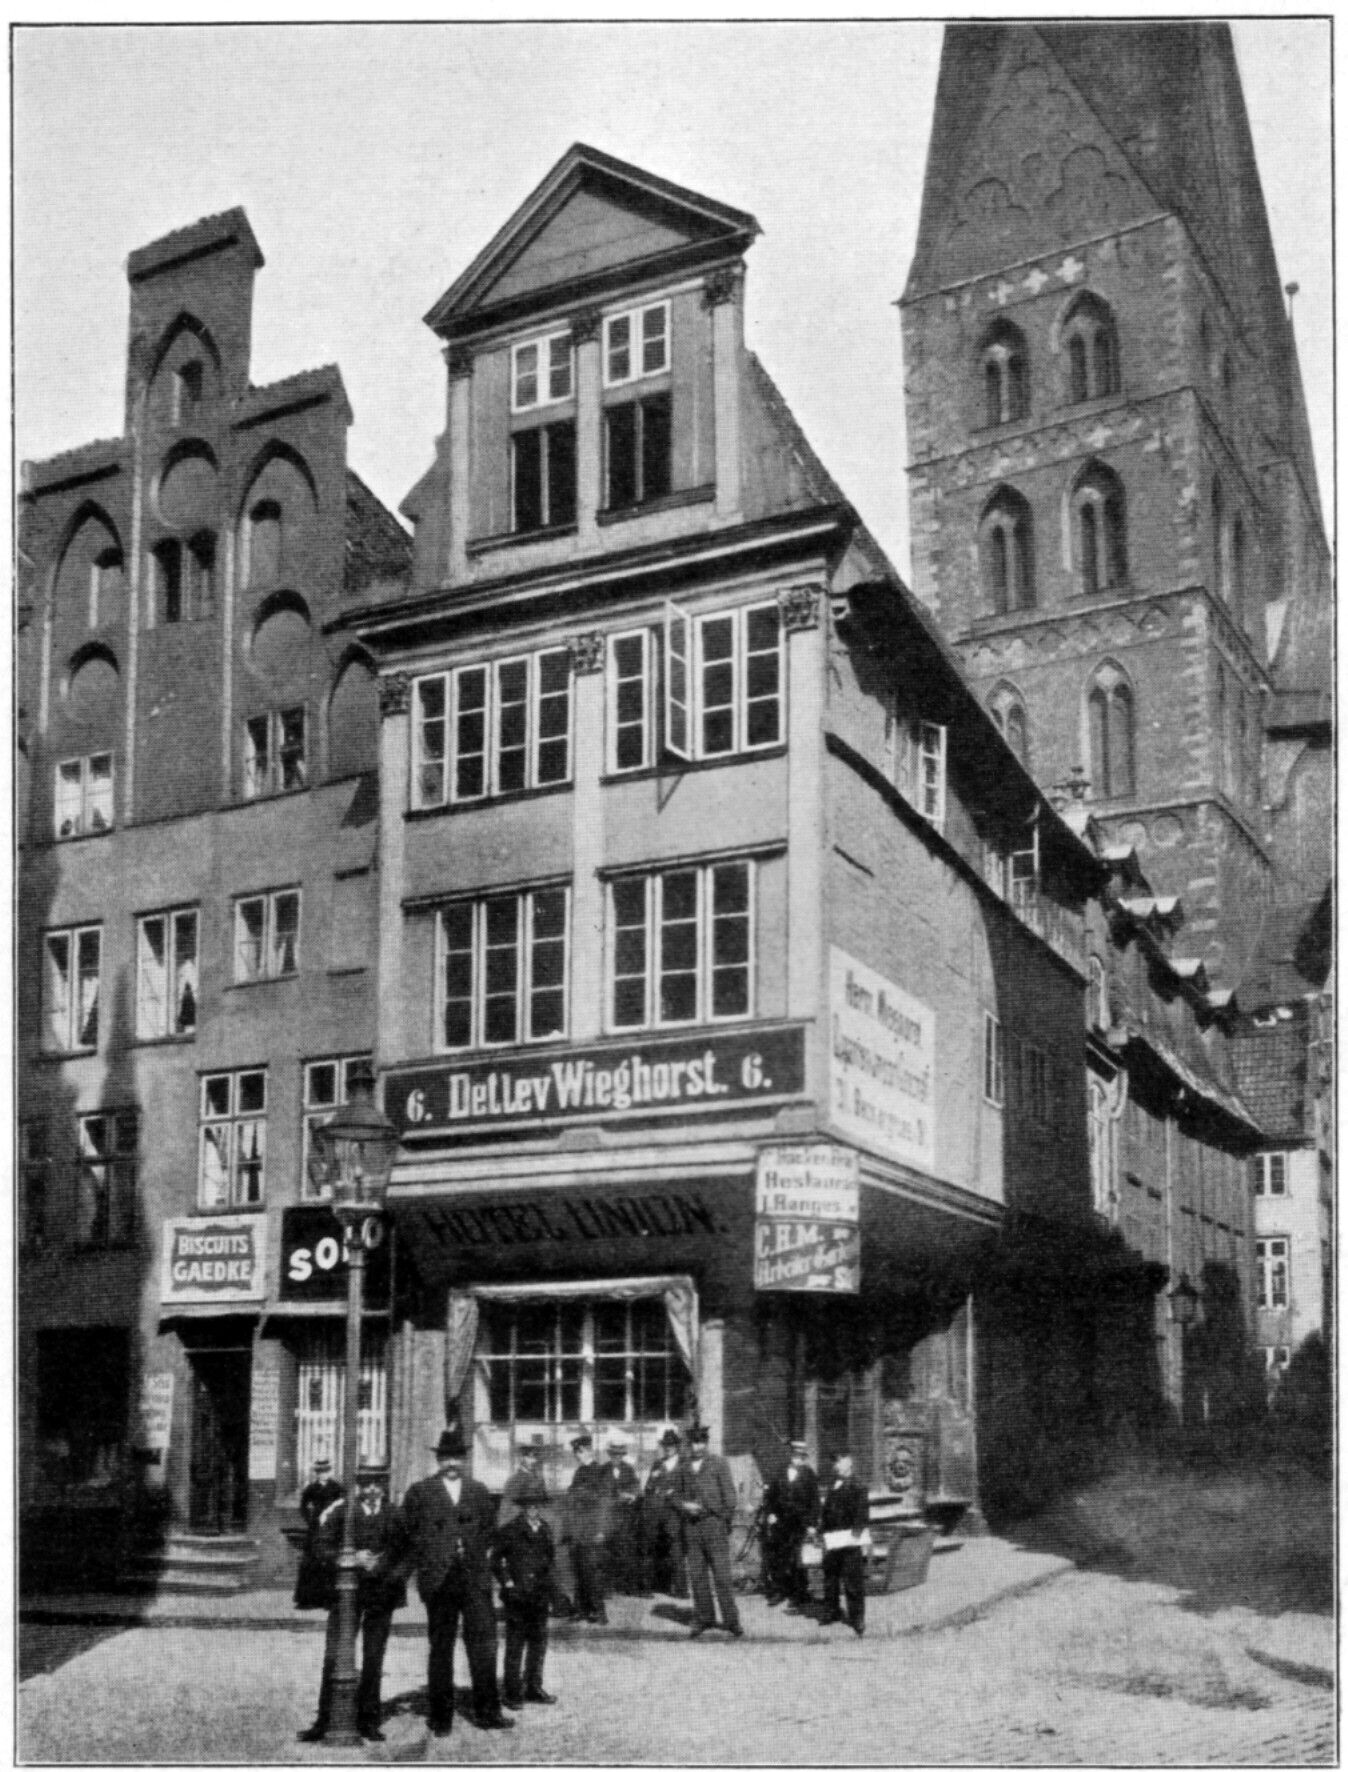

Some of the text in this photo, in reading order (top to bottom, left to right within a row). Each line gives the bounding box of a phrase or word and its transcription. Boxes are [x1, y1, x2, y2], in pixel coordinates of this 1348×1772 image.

[406, 1088, 432, 1122] 6.
[551, 1049, 728, 1109] Wieghorst.
[740, 1053, 773, 1089] 6.
[422, 1202, 567, 1245] HOTEL
[178, 1234, 250, 1256] BISCUITS
[173, 1260, 251, 1282] GAEDKE
